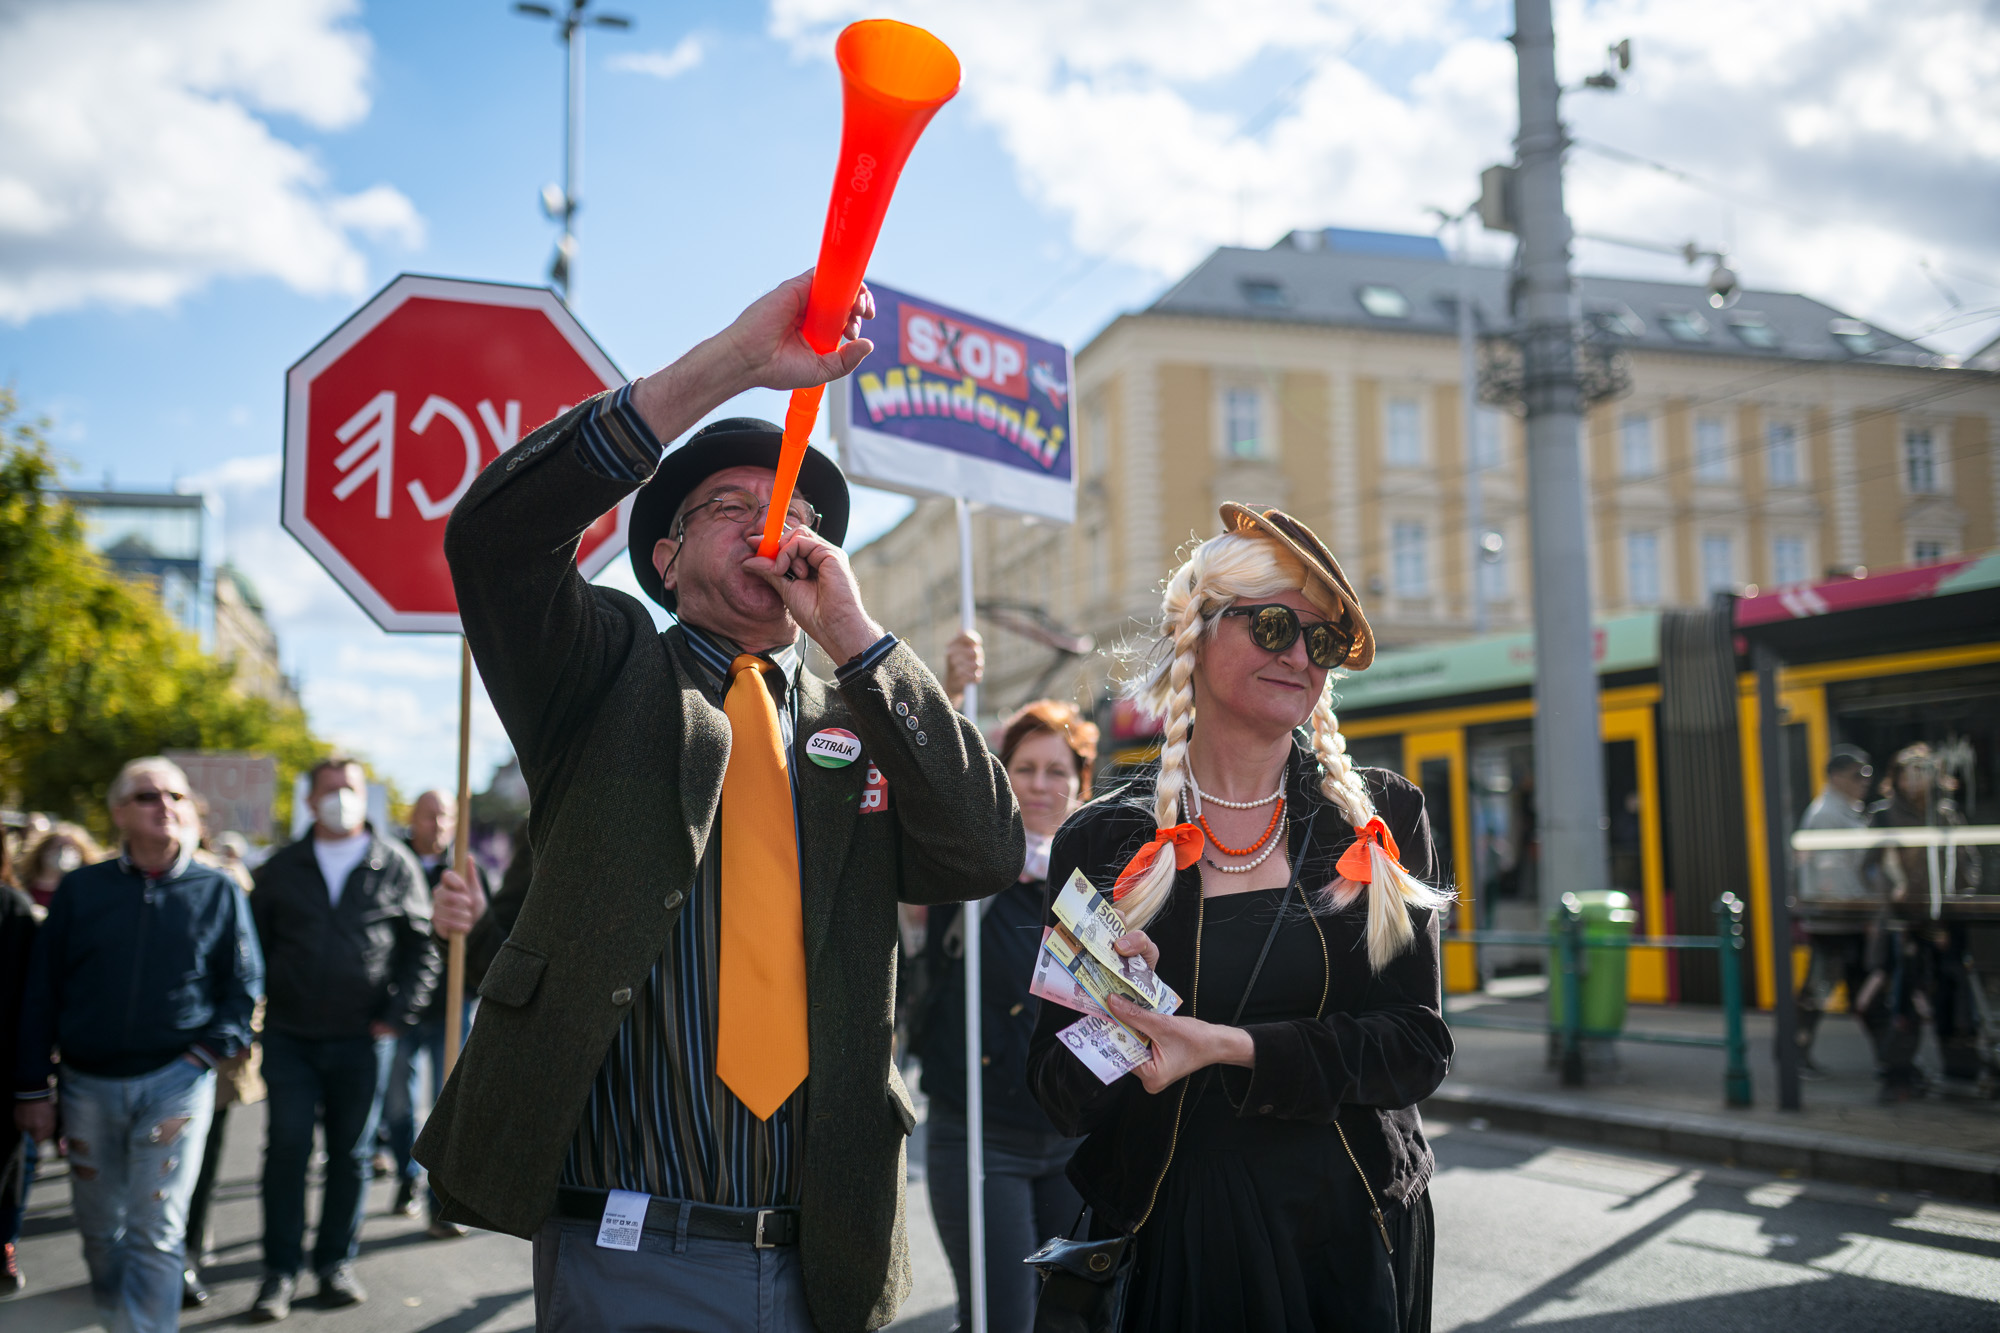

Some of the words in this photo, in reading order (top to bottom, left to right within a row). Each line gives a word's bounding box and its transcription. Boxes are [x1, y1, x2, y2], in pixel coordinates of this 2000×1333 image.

[857, 365, 1066, 469] Mindenki
[811, 737, 856, 757] SZTRÁJK
[1098, 904, 1127, 939] 5000
[1132, 975, 1156, 1002] 5000
